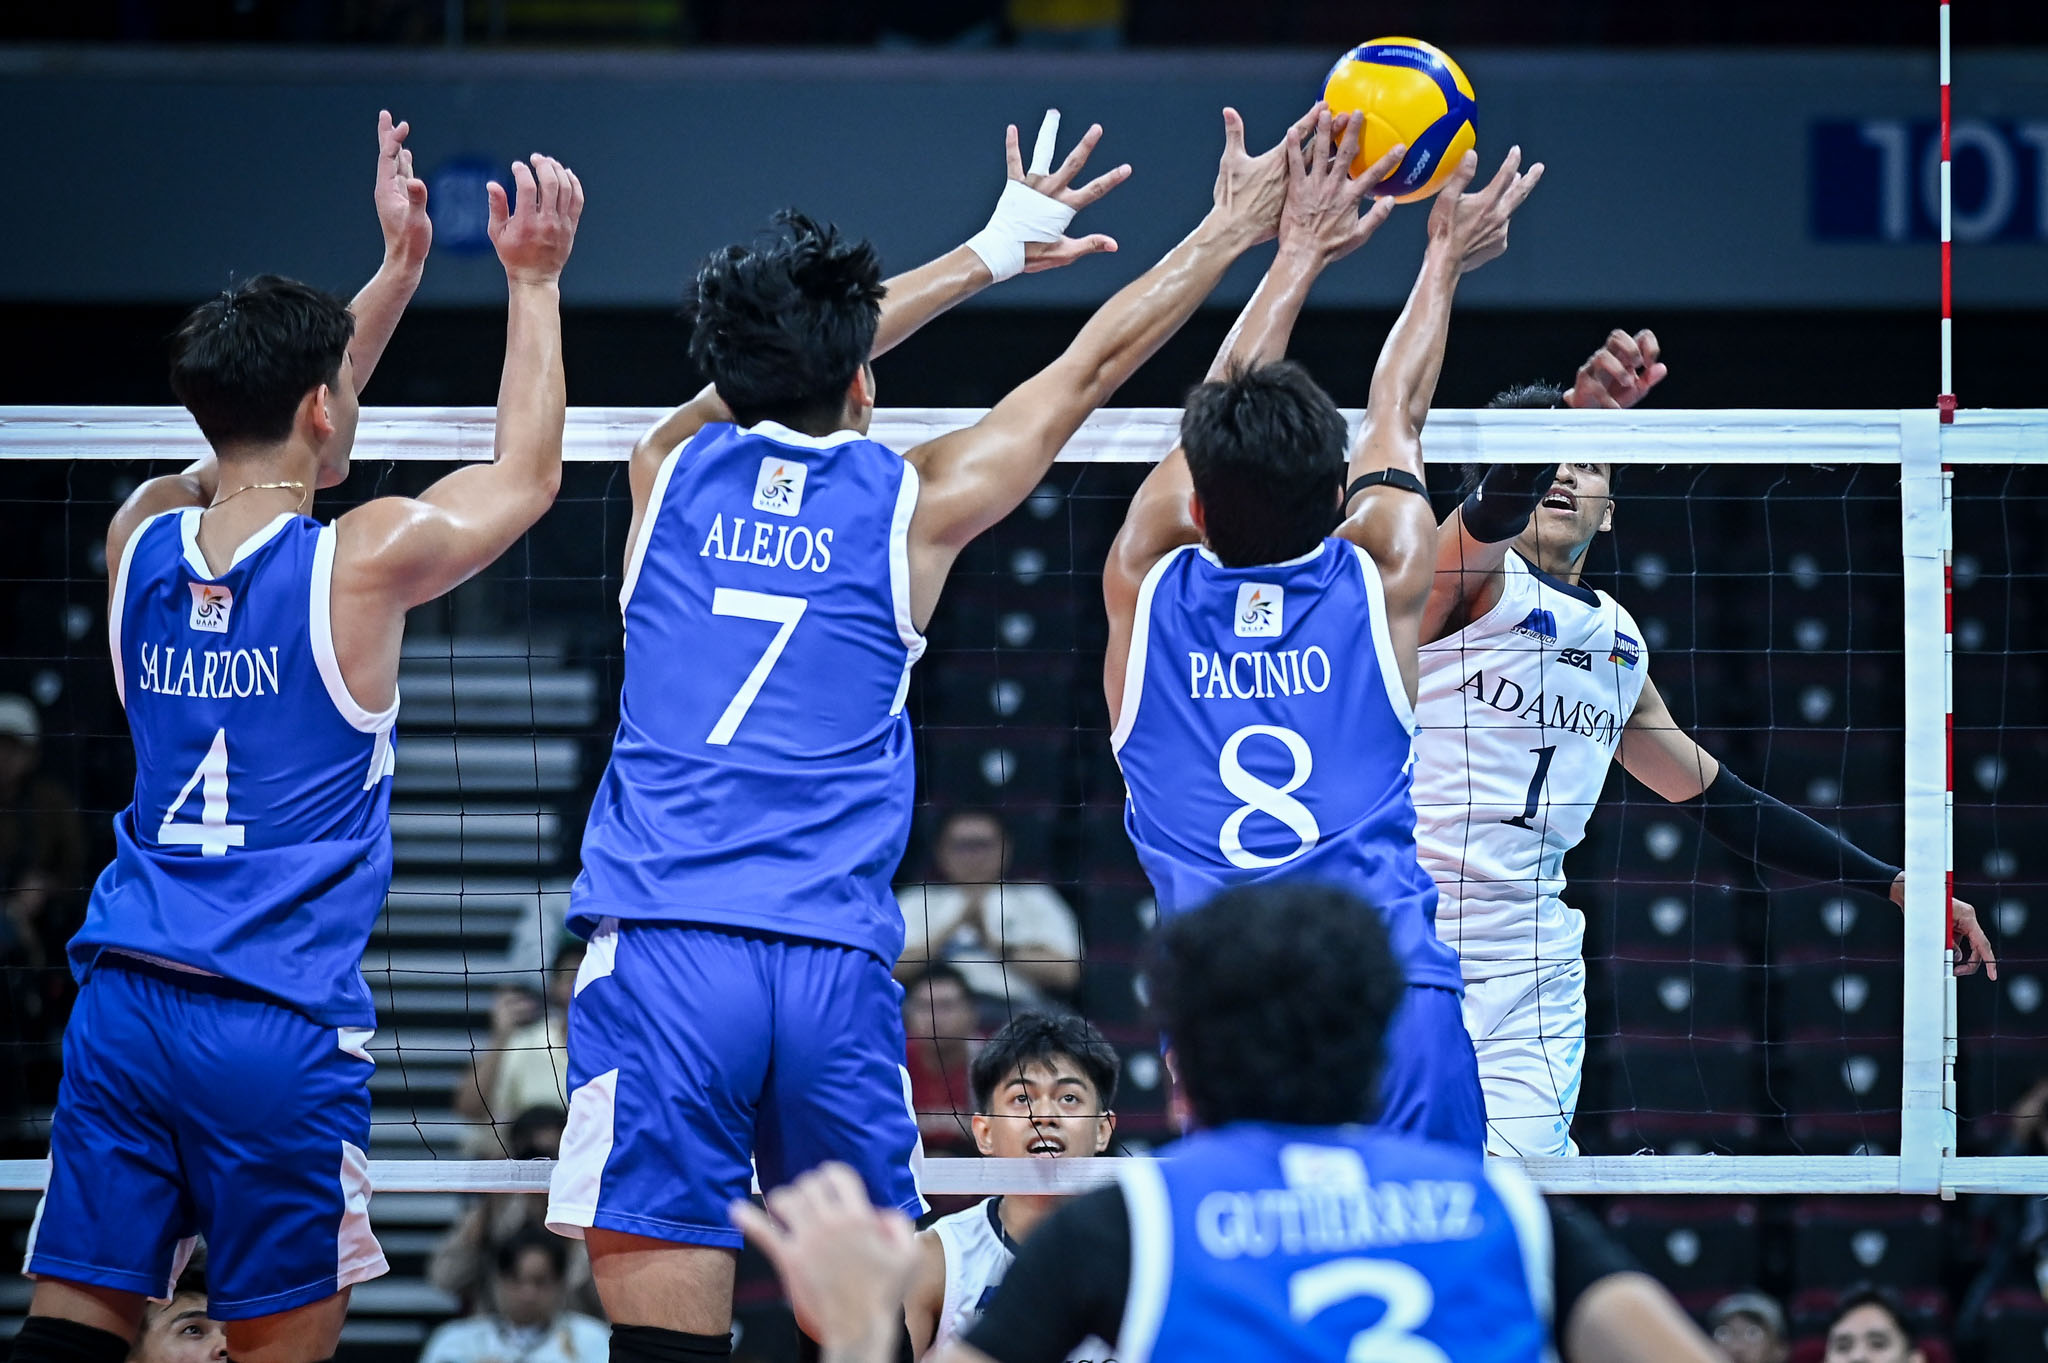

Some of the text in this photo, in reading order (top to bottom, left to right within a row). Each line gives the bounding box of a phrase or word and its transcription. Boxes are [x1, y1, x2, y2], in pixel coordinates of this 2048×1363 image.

[700, 512, 834, 573] ALEJOS
[196, 619, 217, 627] UAAP
[1510, 625, 1557, 645] STONERICH
[1614, 637, 1639, 658] DAVIES
[139, 642, 279, 699] SALARZON
[706, 587, 808, 746] 7
[1188, 645, 1332, 700] PACINIO
[1454, 669, 1623, 747] ADAMSON
[157, 727, 245, 857] 4
[1218, 724, 1320, 870] 8
[1500, 745, 1557, 831] 1
[1289, 1257, 1454, 1363] 3
